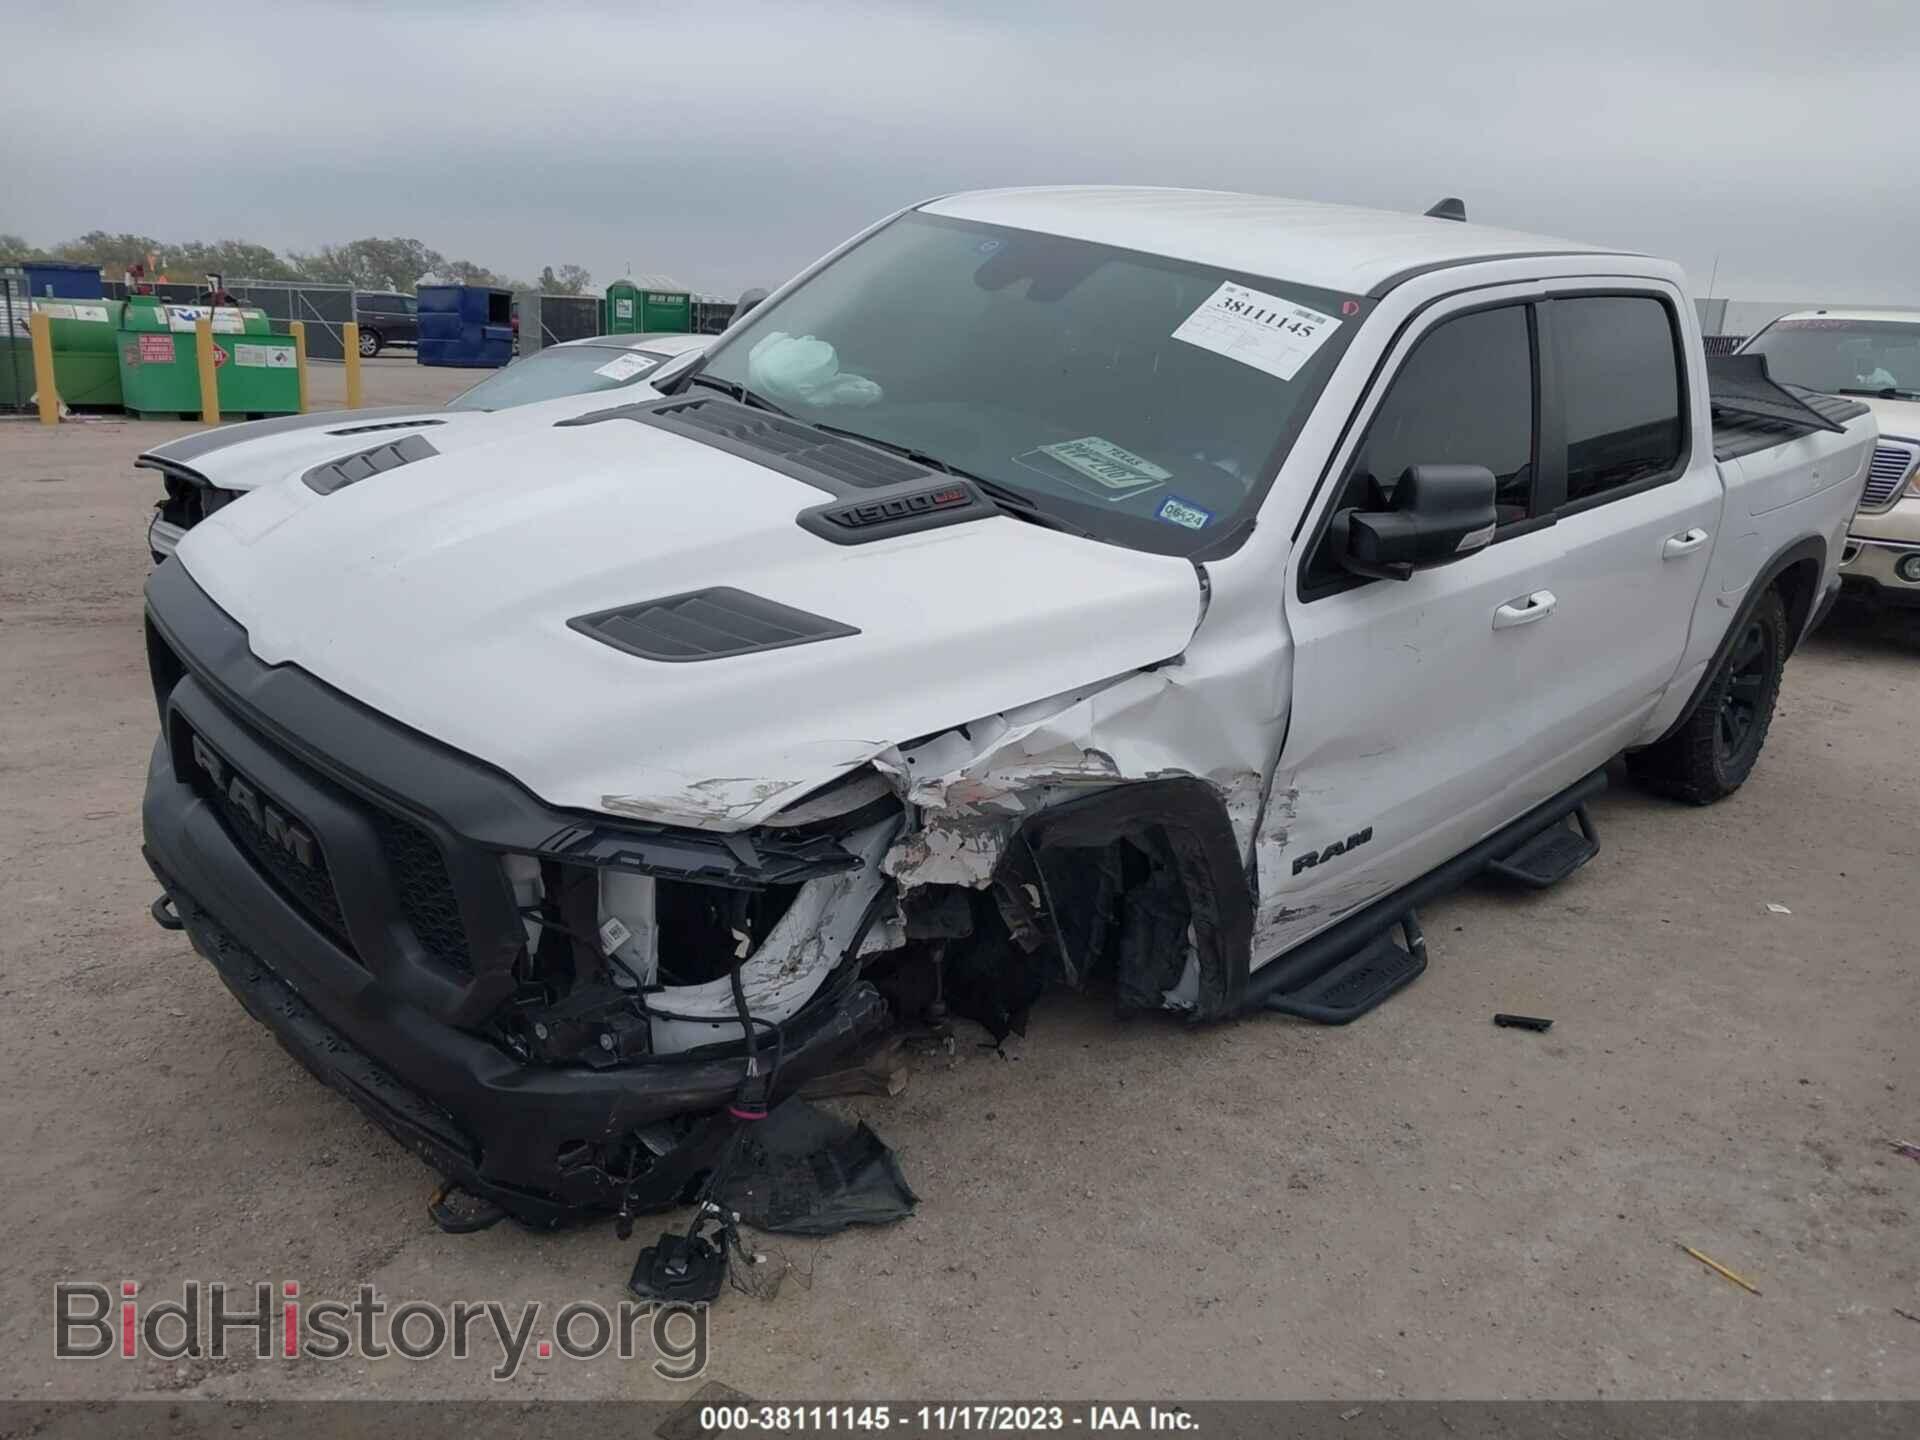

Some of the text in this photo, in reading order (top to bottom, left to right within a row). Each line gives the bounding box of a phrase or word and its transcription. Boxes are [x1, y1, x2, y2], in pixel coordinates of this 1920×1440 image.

[1217, 297, 1315, 337] 38111145
[1106, 447, 1144, 466] TEXAS
[192, 733, 312, 867] RAM
[1292, 825, 1373, 876] RAM
